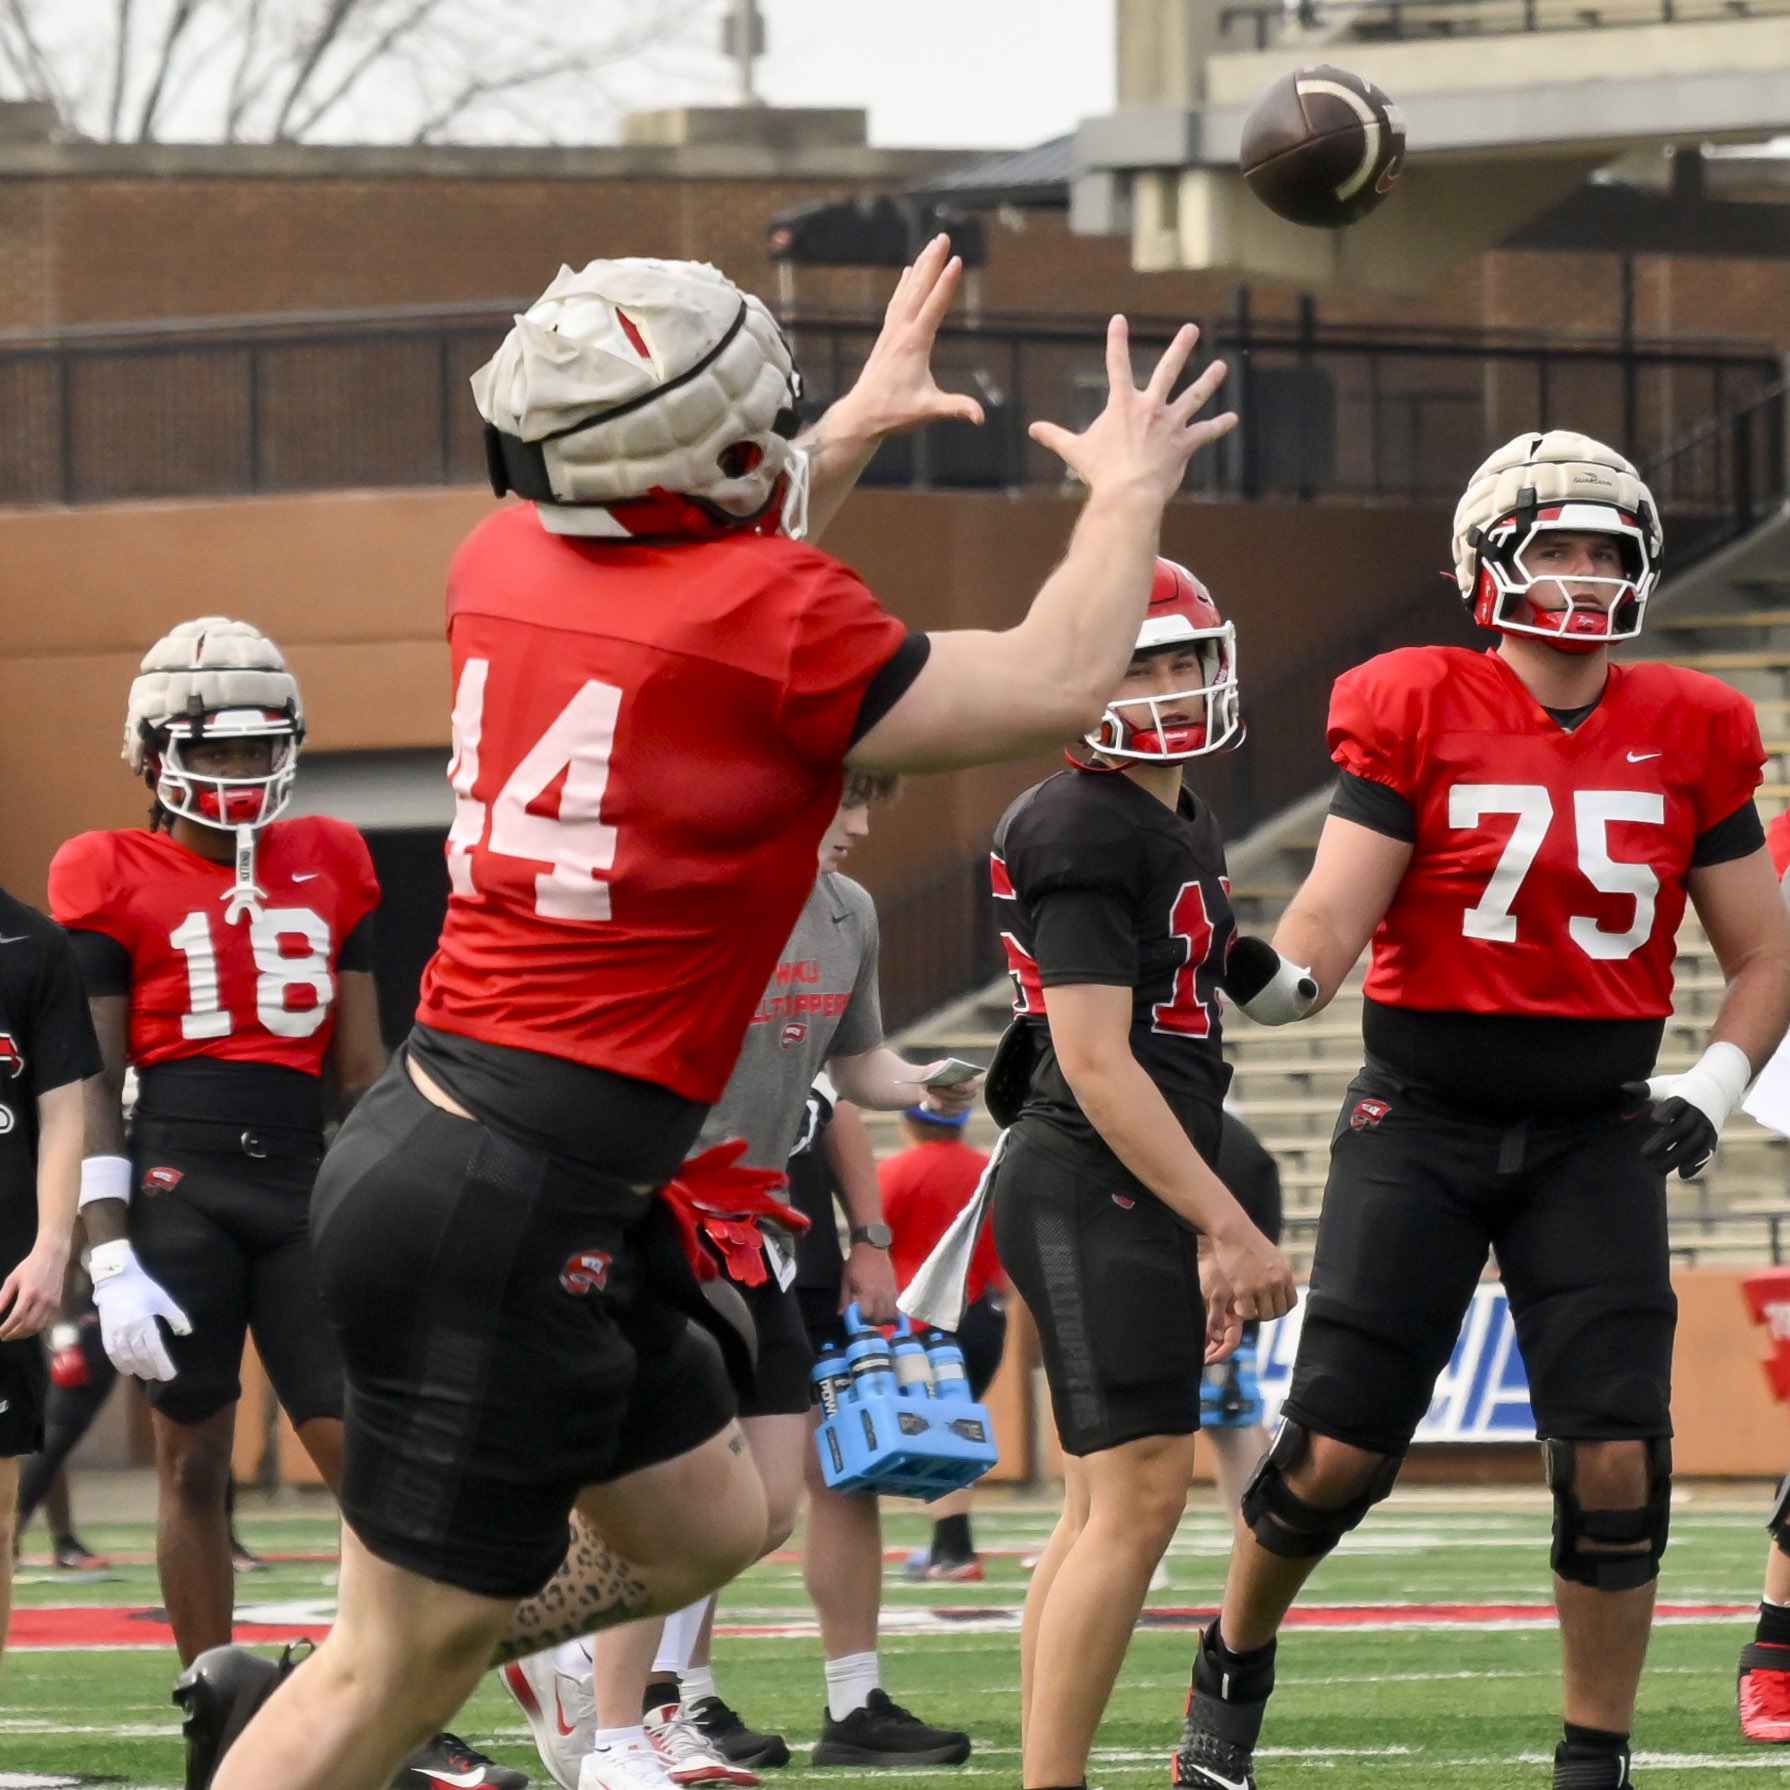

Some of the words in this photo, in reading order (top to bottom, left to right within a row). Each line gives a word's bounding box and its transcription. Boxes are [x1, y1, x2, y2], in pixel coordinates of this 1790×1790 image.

[1448, 784, 1665, 960] 75
[169, 907, 334, 1040] 18
[776, 959, 819, 986] WKU
[1151, 876, 1240, 1039] 1
